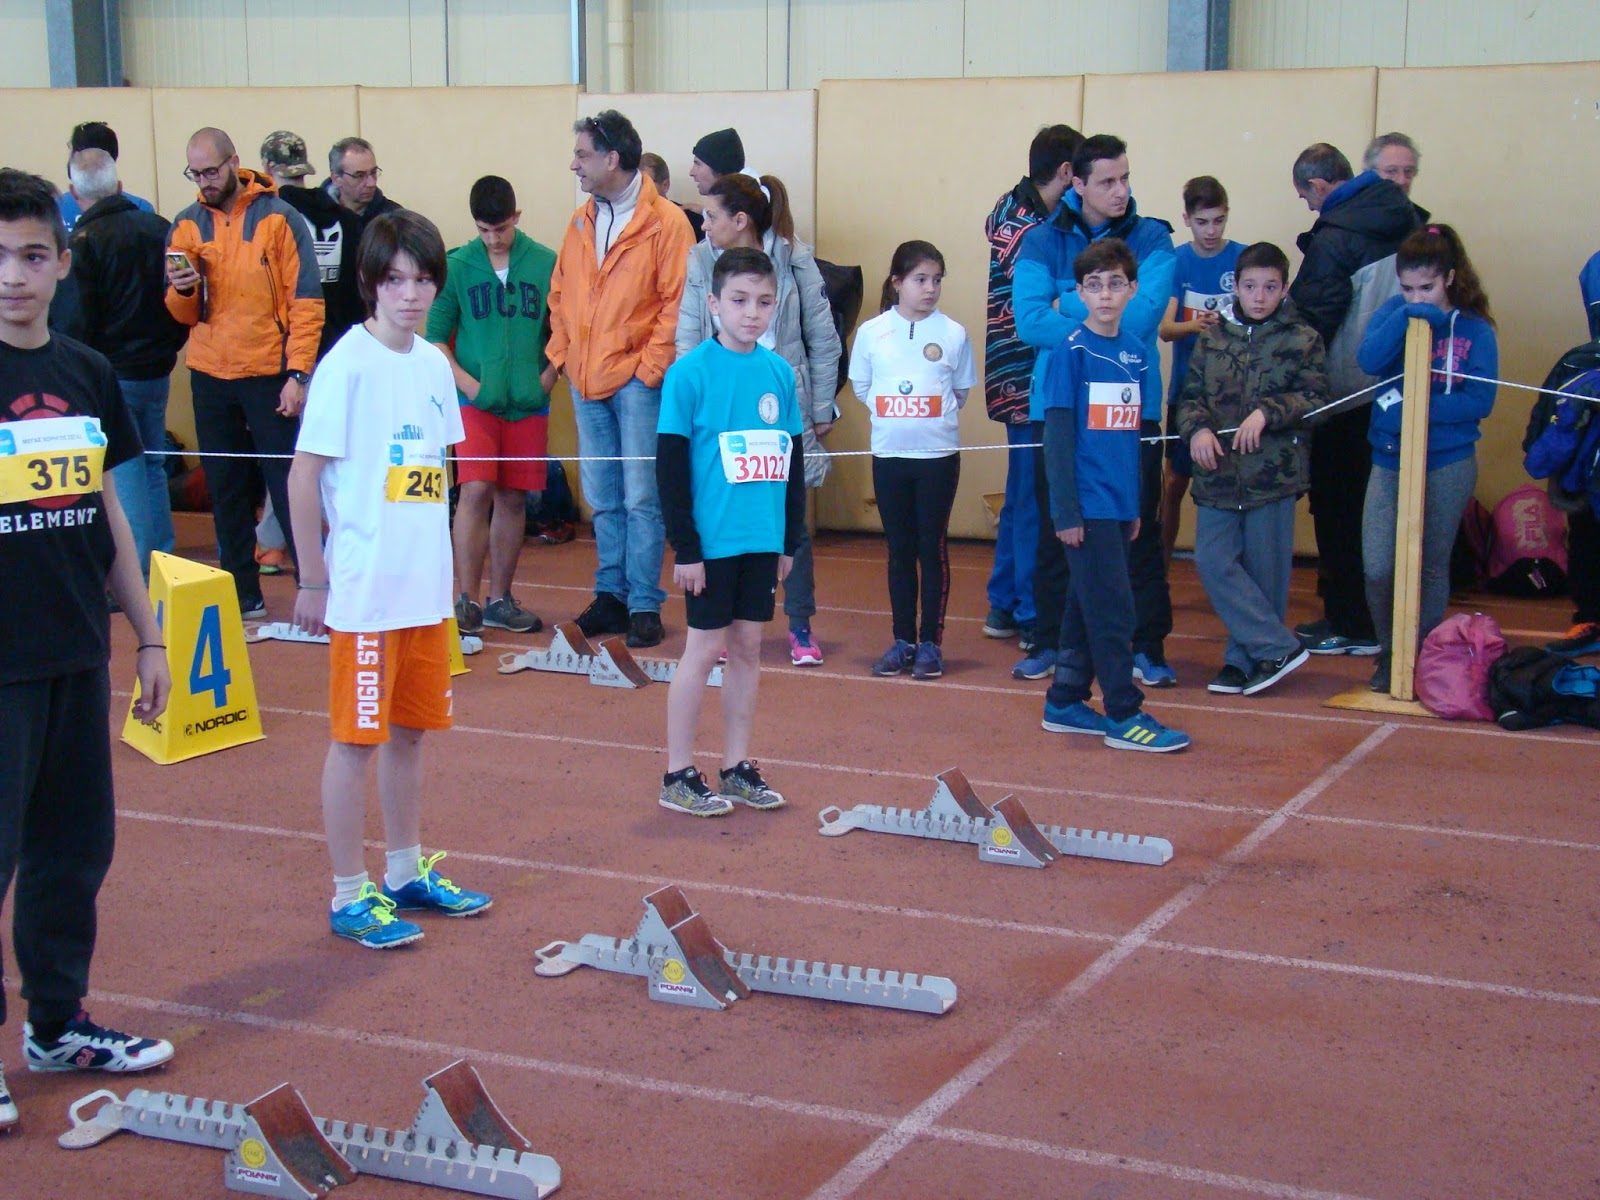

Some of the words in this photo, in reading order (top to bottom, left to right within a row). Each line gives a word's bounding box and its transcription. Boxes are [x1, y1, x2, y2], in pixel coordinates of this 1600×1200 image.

[467, 281, 542, 320] UCB
[884, 397, 931, 417] 2055
[1105, 406, 1139, 427] 1227
[27, 455, 91, 491] 375
[734, 455, 785, 480] 32122
[405, 470, 442, 498] 243
[0, 507, 97, 534] ELEMENT
[189, 604, 231, 709] 4
[357, 671, 379, 730] POGO
[195, 709, 247, 734] NORDIC
